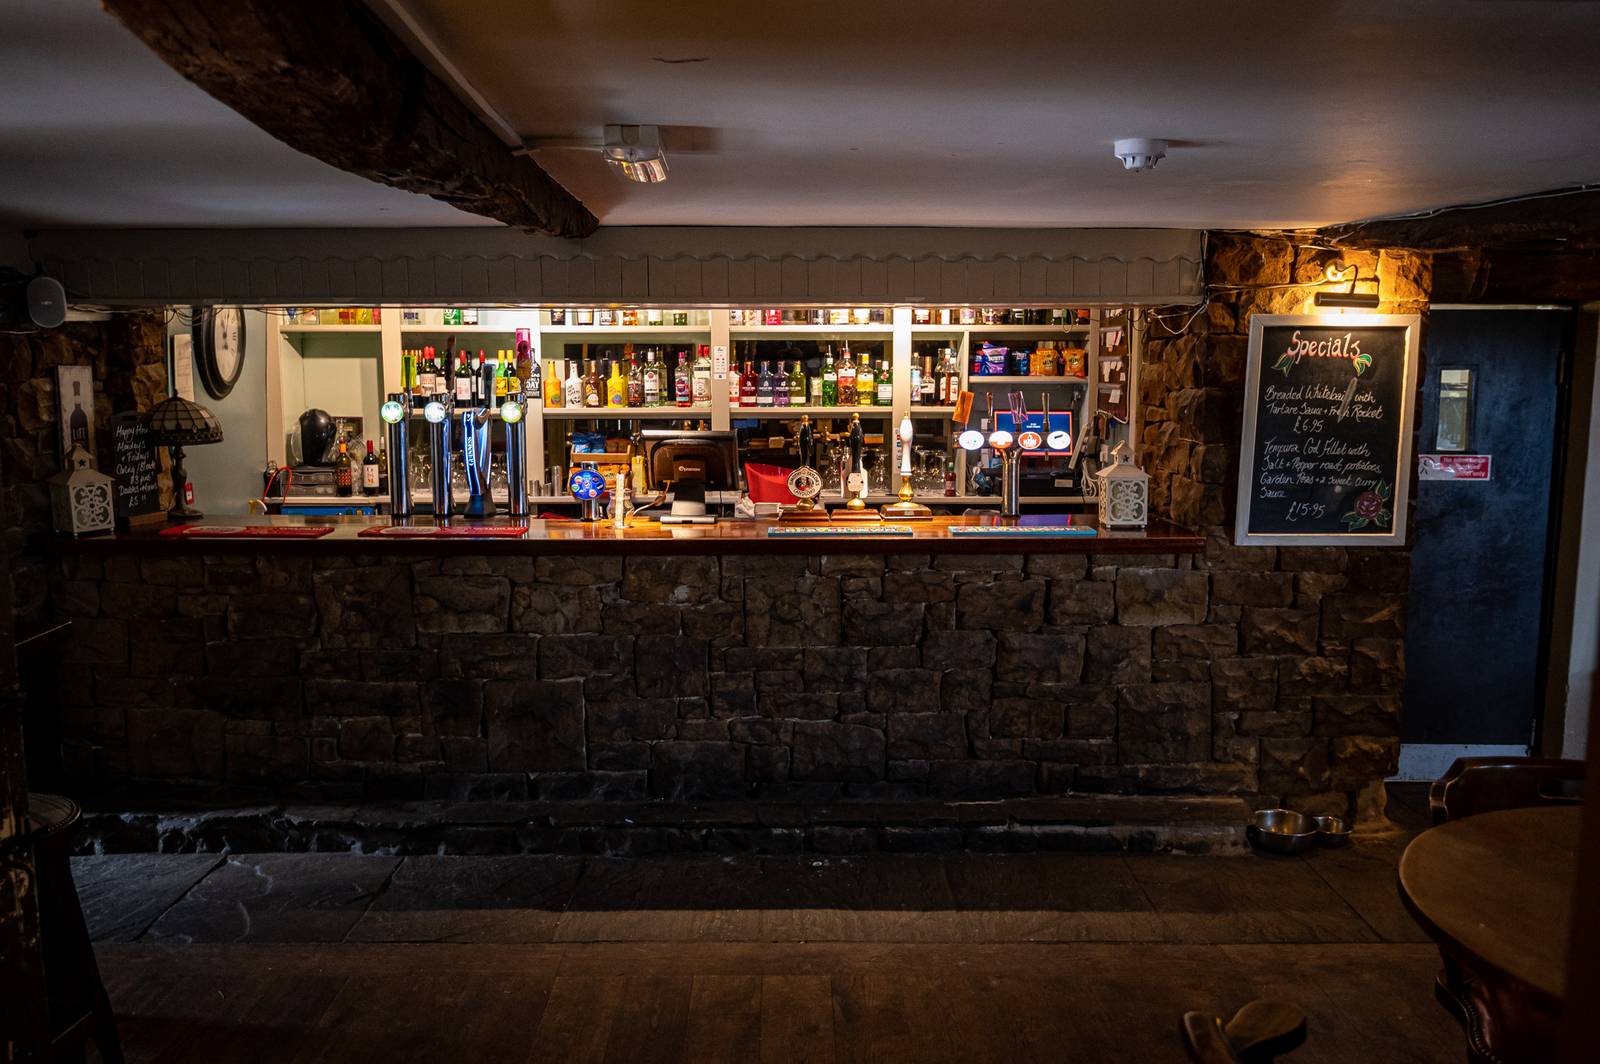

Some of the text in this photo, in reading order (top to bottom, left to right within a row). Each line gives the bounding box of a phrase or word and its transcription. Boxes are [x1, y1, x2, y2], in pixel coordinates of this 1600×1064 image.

[1286, 330, 1360, 364] Specials
[1264, 383, 1376, 405] Breaded Whitebai with
[1266, 401, 1298, 416] Tartare
[1351, 404, 1384, 423] Rocket
[1293, 416, 1324, 433] £6.95
[467, 436, 475, 466] GUINNESS
[1263, 436, 1300, 457] Tempura
[1303, 437, 1321, 455] Cod
[1347, 441, 1371, 456] with
[1261, 455, 1285, 471] Salt
[1291, 456, 1319, 472] Pepper
[1260, 472, 1295, 486] Garden
[1285, 501, 1326, 522] £15.95
